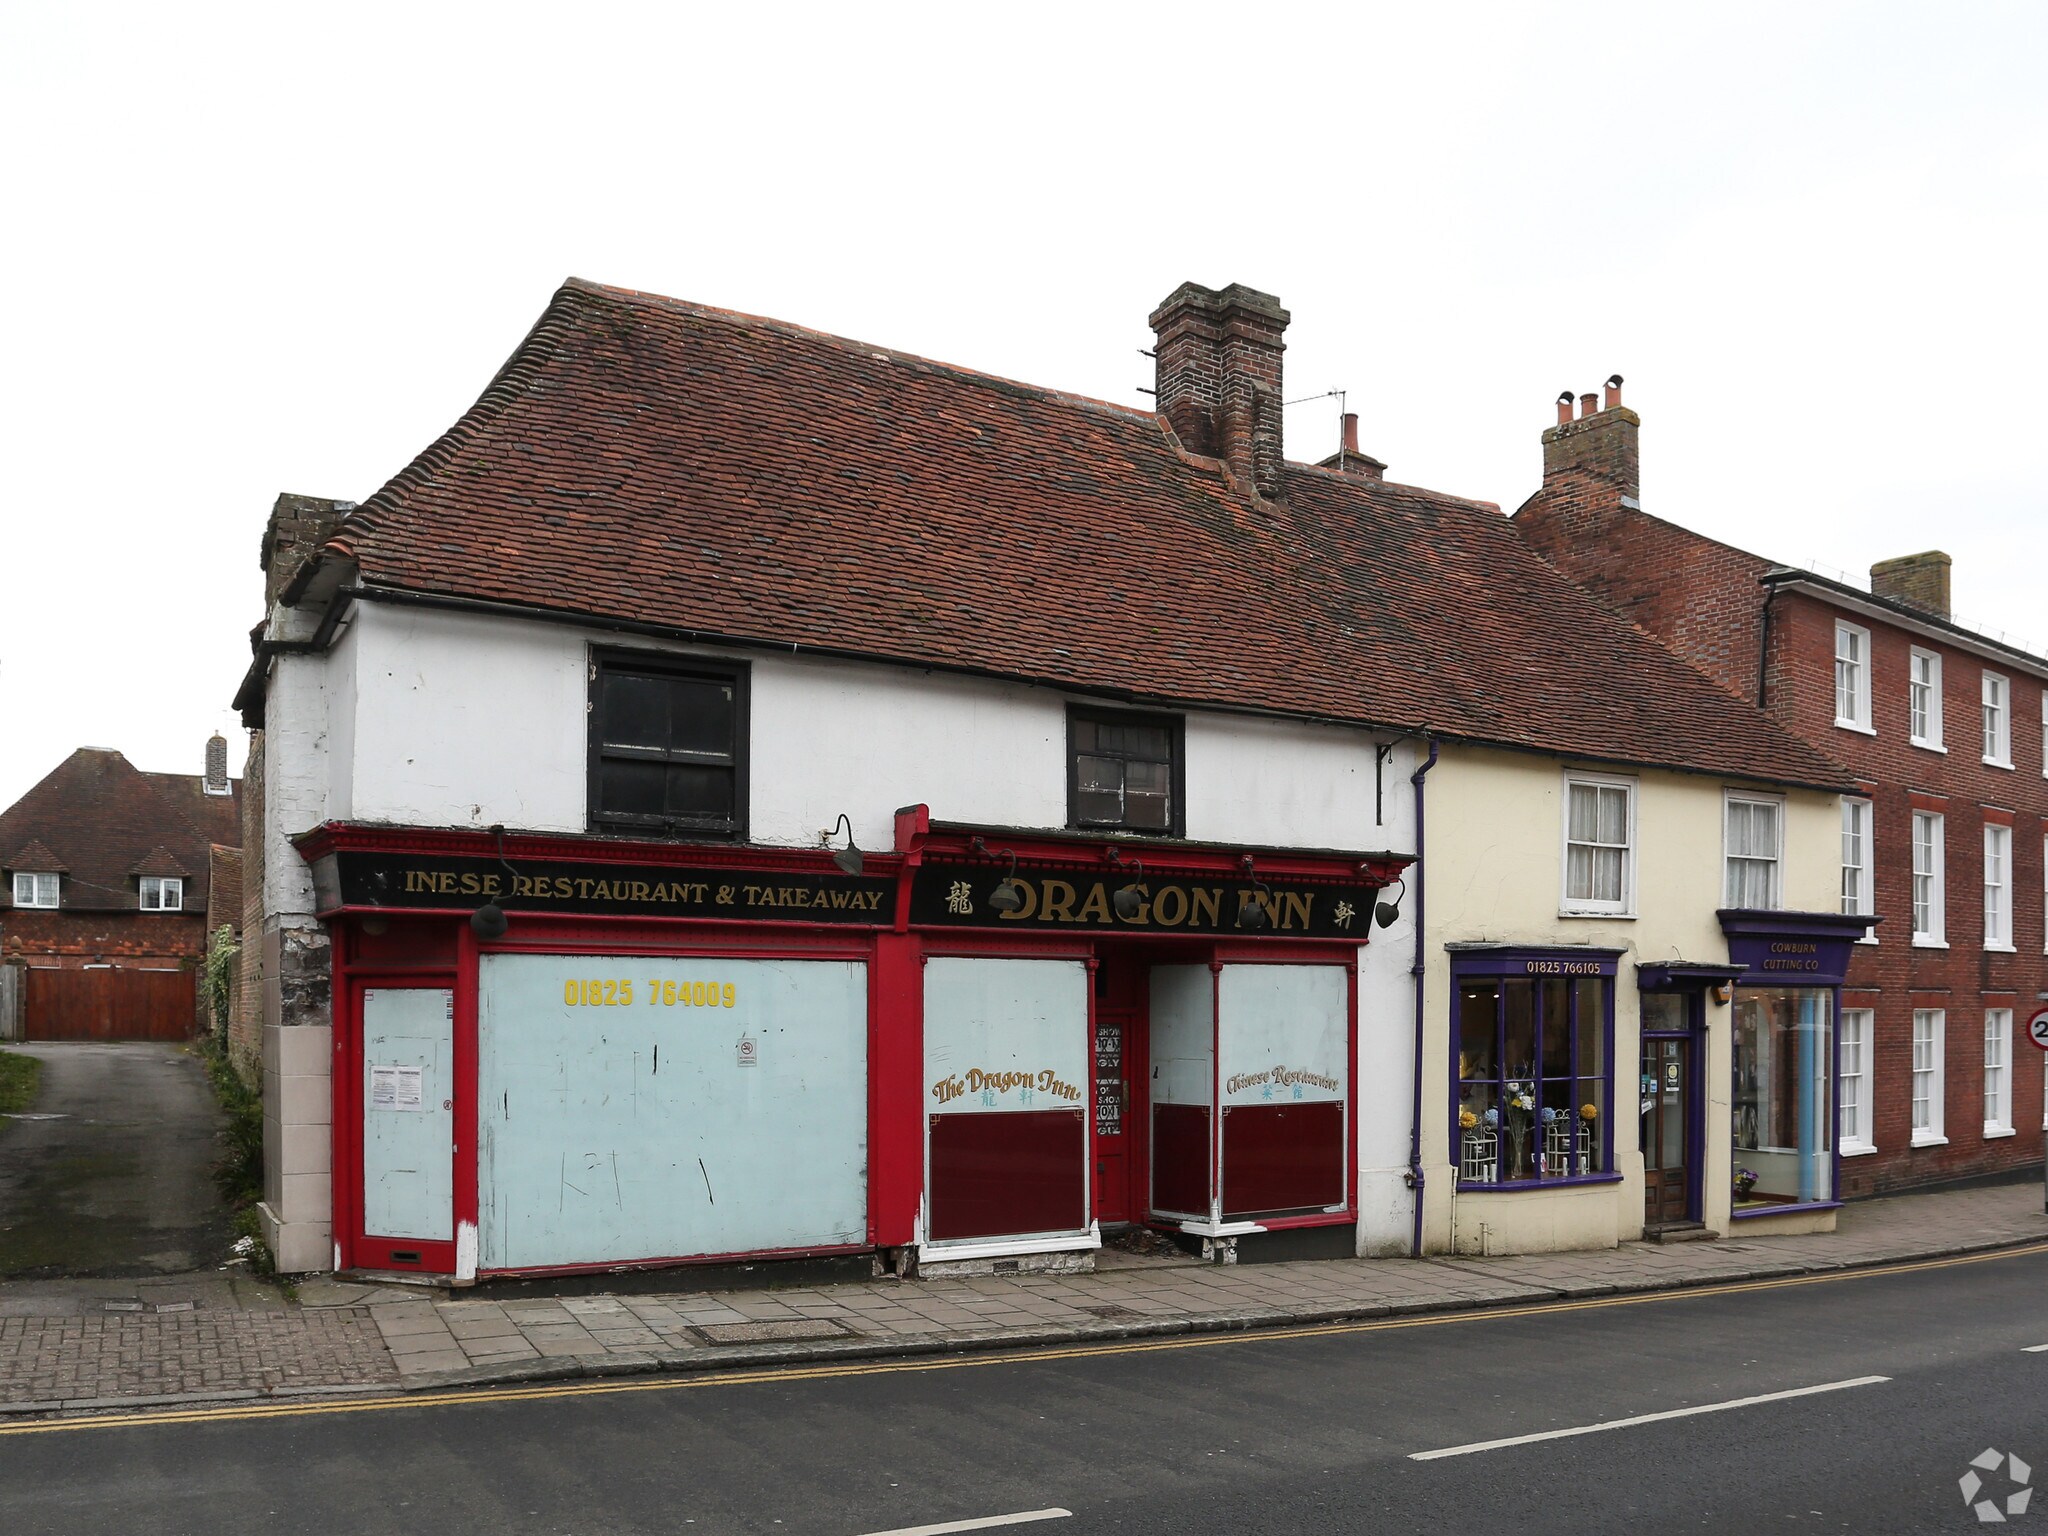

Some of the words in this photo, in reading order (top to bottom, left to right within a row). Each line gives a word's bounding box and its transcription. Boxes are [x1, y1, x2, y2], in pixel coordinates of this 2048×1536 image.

[513, 876, 708, 903] RESTAURANT
[715, 885, 736, 905] &
[743, 885, 884, 910] TAKEAWAY
[945, 881, 974, 914] 龍
[1771, 942, 1817, 953] COWBURN
[1527, 961, 1560, 973] 01825
[1563, 962, 1600, 974] 766105
[1763, 959, 1802, 970] CUTTING
[1805, 960, 1819, 970] CO
[565, 979, 633, 1007] 01825
[649, 979, 736, 1008] 764009
[932, 1074, 965, 1104] The
[965, 1068, 1035, 1094] Dragon
[1038, 1070, 1081, 1101] Inn
[1226, 1071, 1270, 1095] Chinese
[1271, 1065, 1339, 1093] Restaurant
